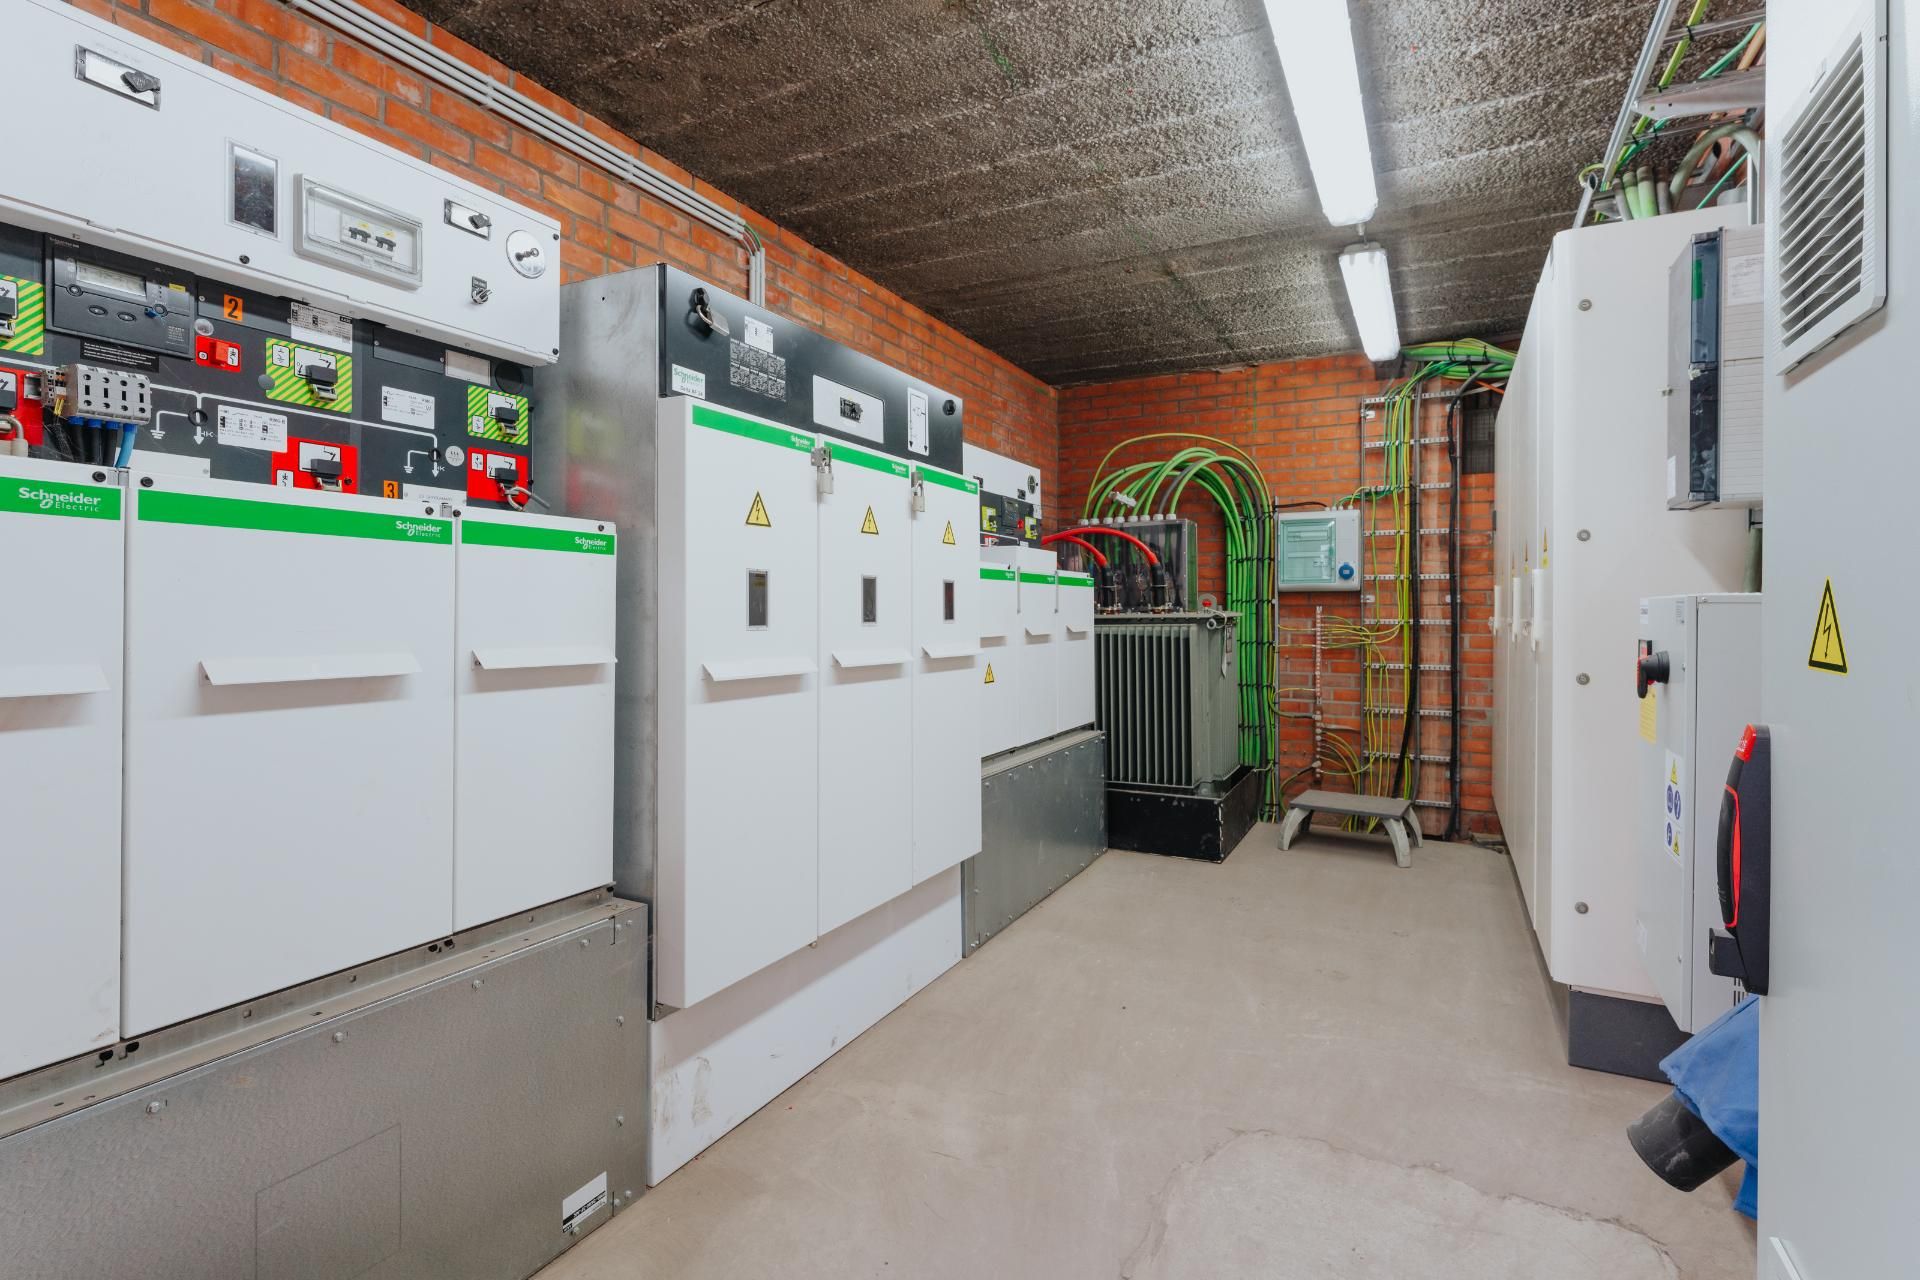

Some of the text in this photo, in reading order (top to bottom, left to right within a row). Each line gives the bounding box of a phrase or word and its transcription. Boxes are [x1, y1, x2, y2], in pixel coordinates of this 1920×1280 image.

[227, 298, 239, 319] 2
[18, 487, 101, 506] Schneider
[386, 482, 395, 499] 3
[55, 501, 101, 513] Electric
[395, 520, 442, 533] Schneider
[415, 530, 441, 538] Electric
[574, 536, 608, 547] Schneider
